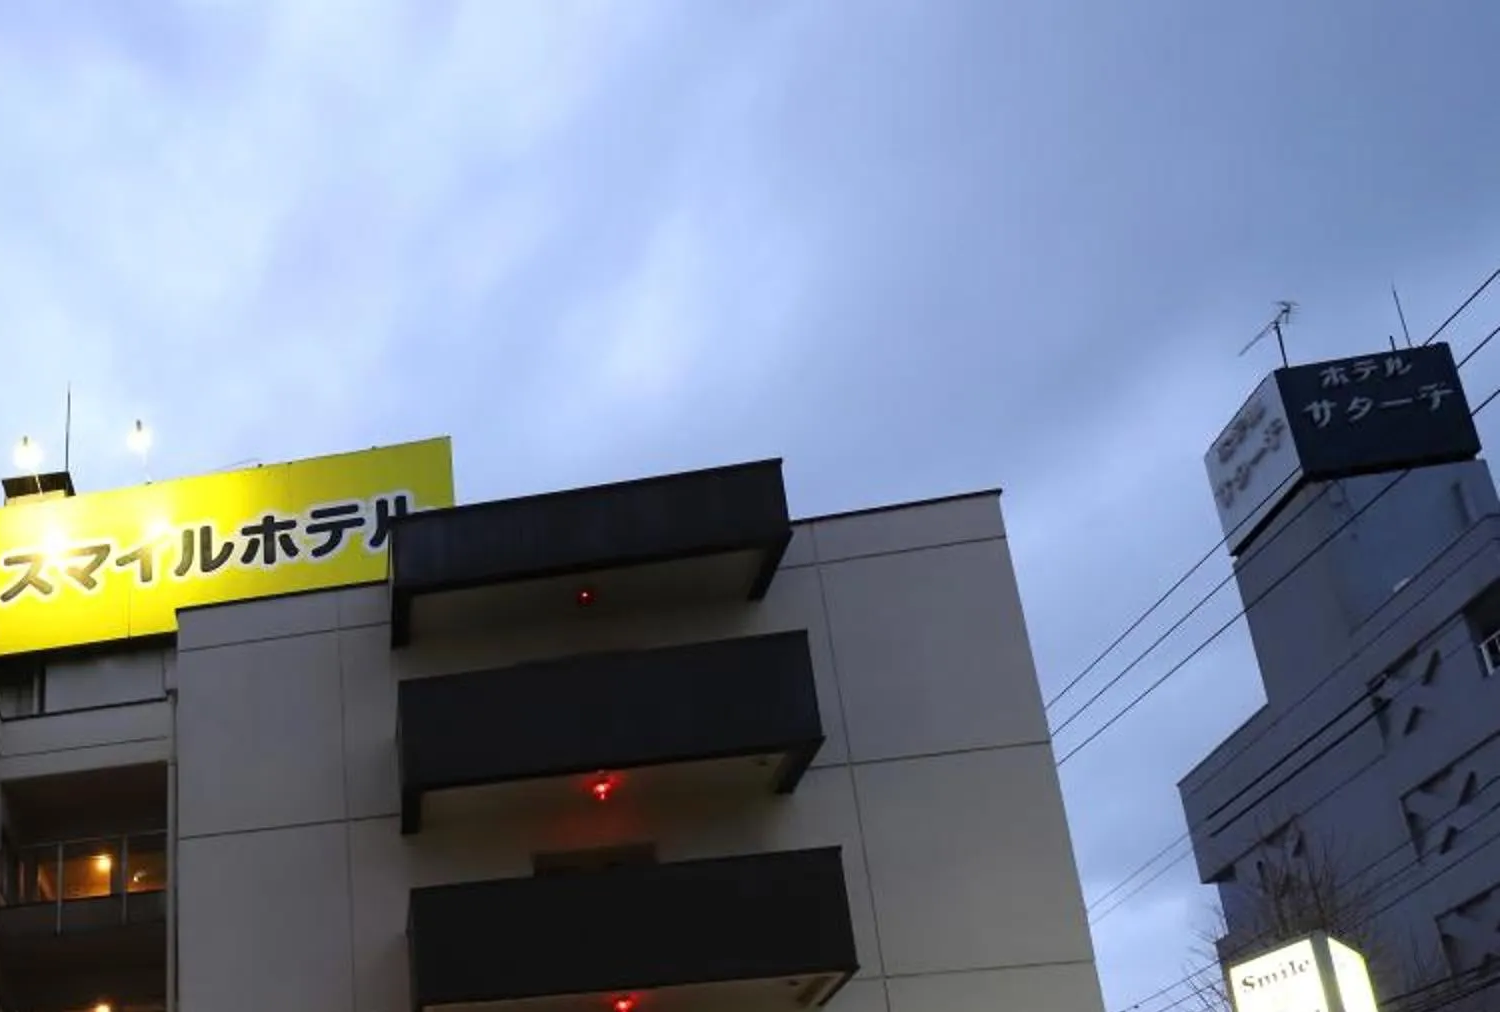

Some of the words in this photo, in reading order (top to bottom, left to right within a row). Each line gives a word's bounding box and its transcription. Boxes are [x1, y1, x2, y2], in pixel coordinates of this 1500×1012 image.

[1319, 356, 1413, 388] ホテル
[0, 495, 407, 602] スマイルホテル
[1240, 959, 1311, 993] Smile
